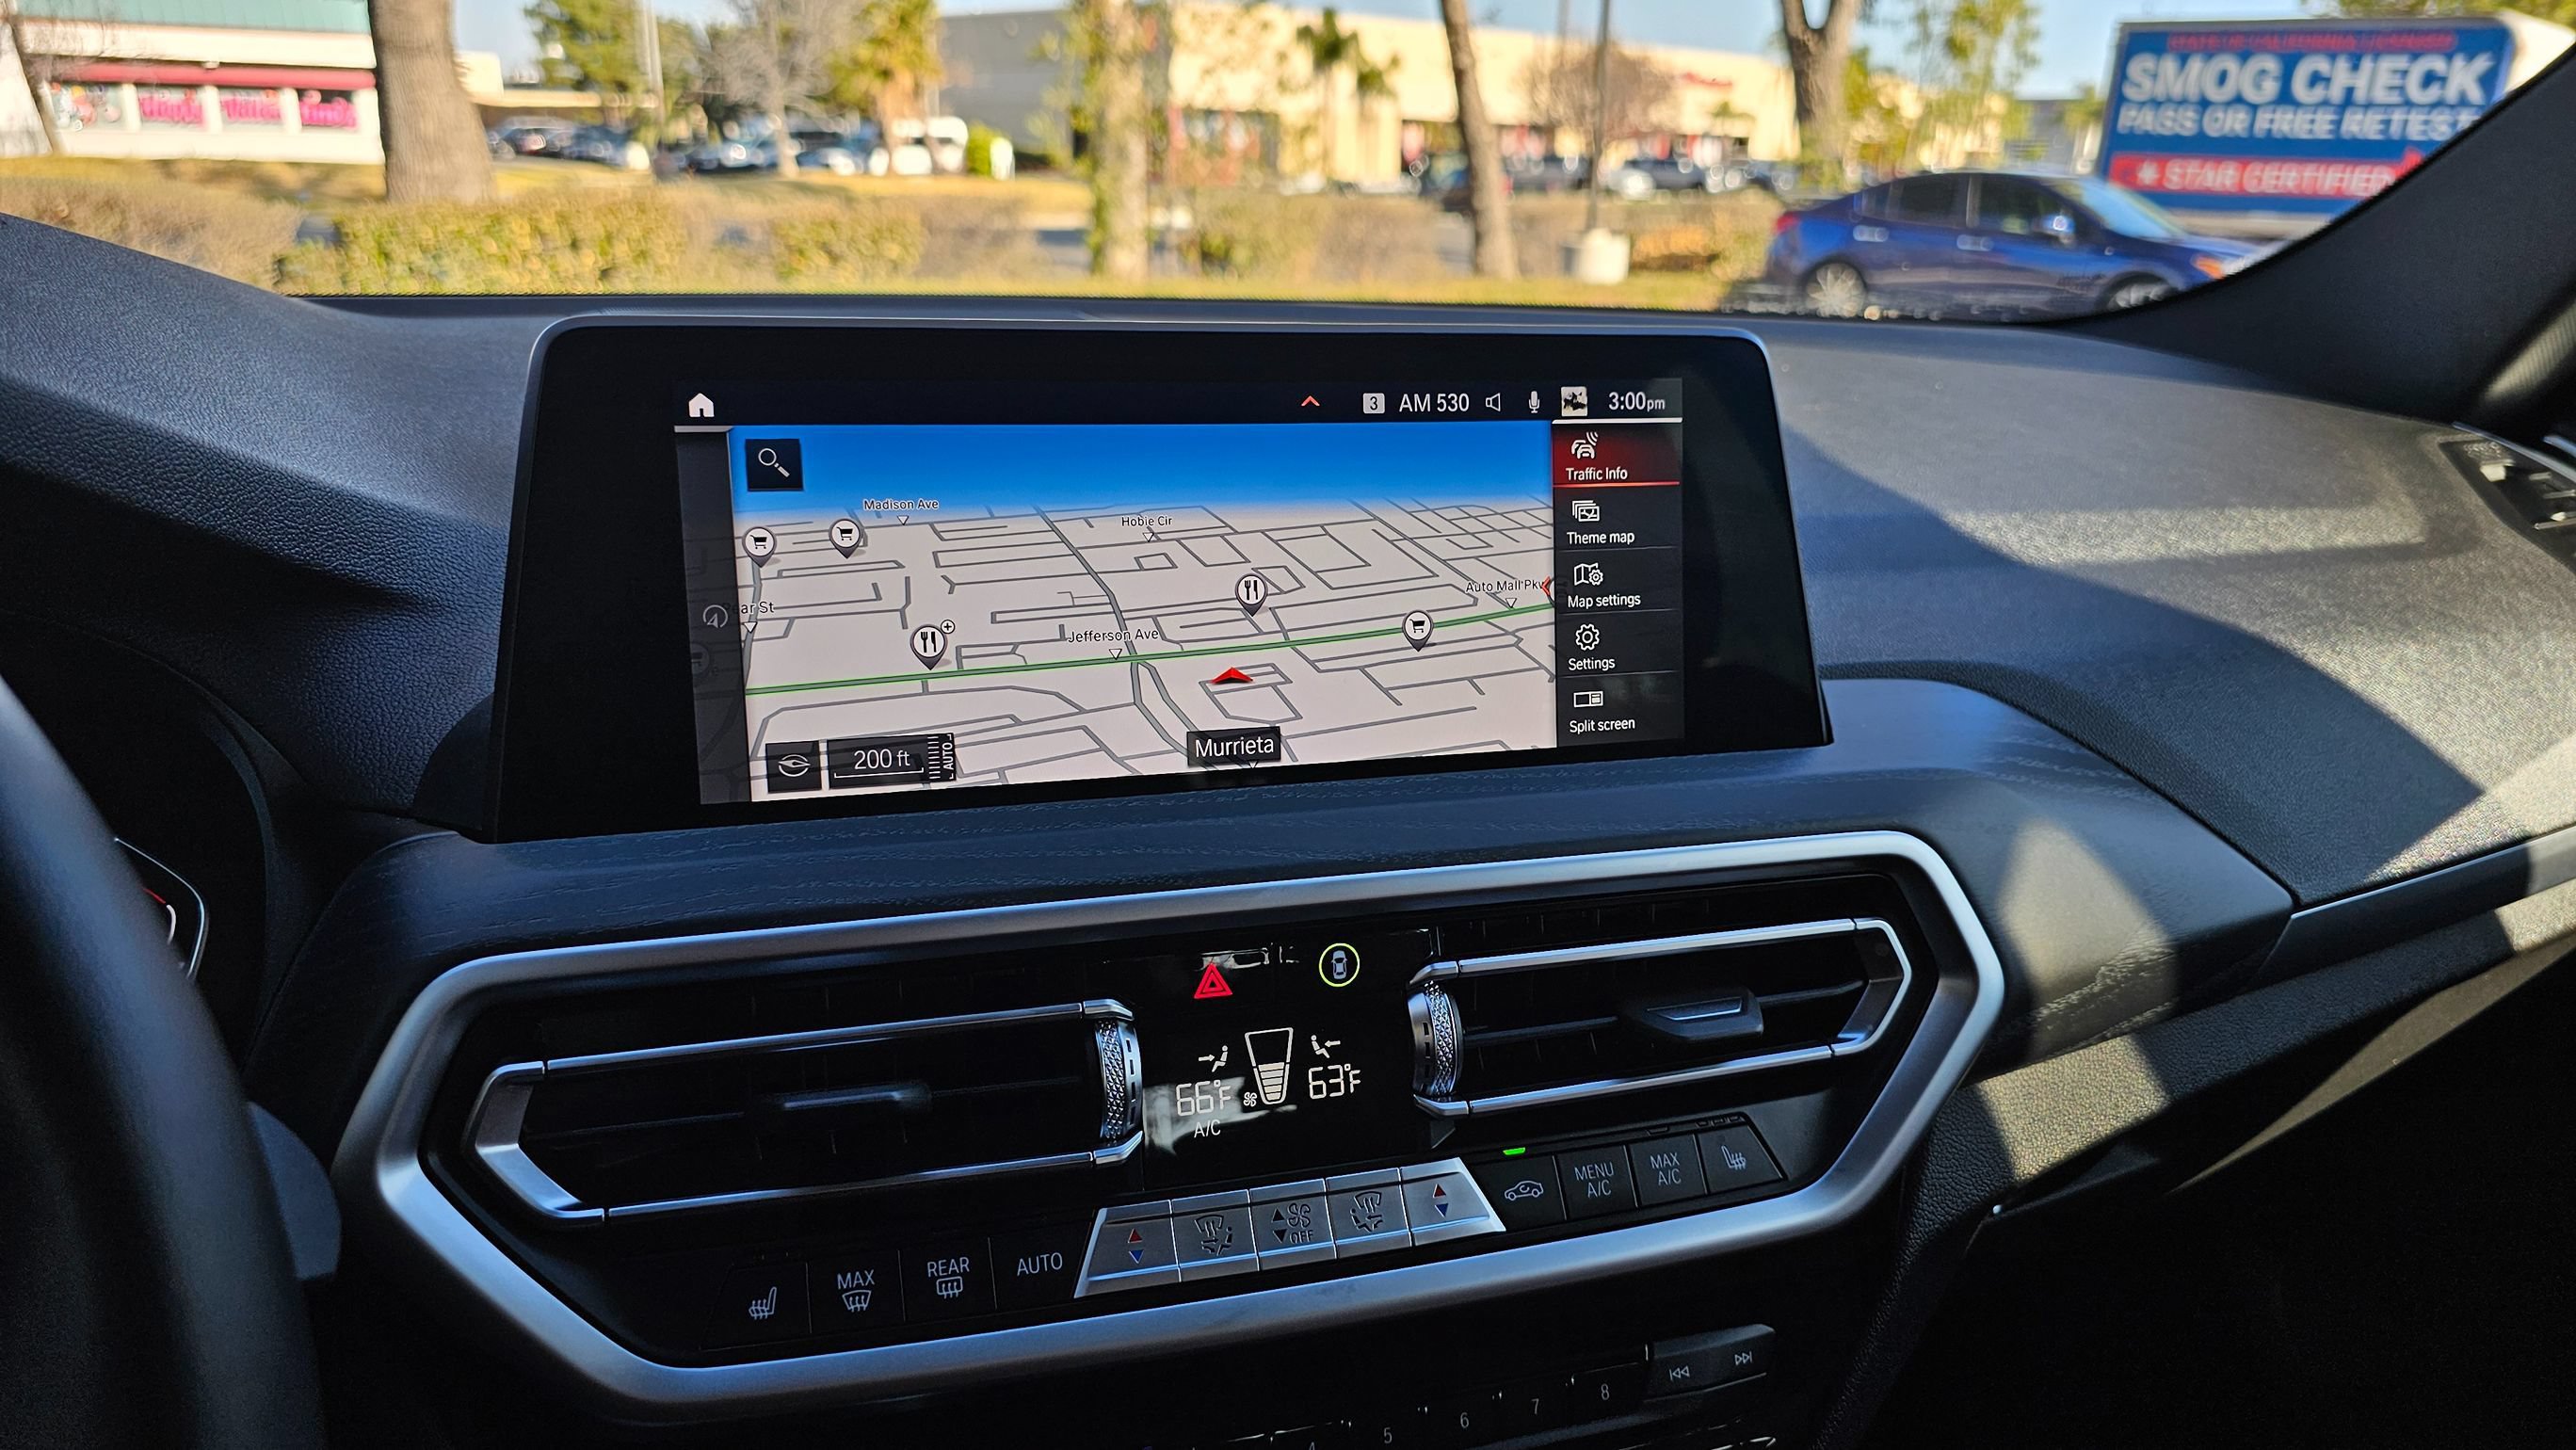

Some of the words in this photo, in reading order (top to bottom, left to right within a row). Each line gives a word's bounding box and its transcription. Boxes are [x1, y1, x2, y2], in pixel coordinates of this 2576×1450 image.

[2122, 53, 2282, 104] SMOG
[2291, 52, 2495, 105] CHECK
[2117, 104, 2199, 137] PASS
[2202, 105, 2250, 137] OR
[2254, 105, 2340, 140] FREE
[2163, 158, 2242, 191] STAR
[1399, 395, 1431, 412] AM
[1437, 394, 1470, 412] 530
[1608, 391, 1666, 411] 3:00pm
[1566, 467, 1602, 481] Traffic
[1605, 467, 1629, 480] Info
[863, 499, 914, 510] Madison
[917, 499, 940, 510] Ave
[1121, 516, 1154, 527] Hobie
[1157, 516, 1172, 525] Cir
[1567, 532, 1606, 545] Theme
[1608, 533, 1635, 546] map
[1466, 580, 1492, 592] Auto
[1496, 579, 1521, 590] Mall
[759, 601, 774, 613] St
[1568, 595, 1593, 610] Map
[1595, 593, 1641, 608] settings
[1068, 629, 1132, 643] Jefferson
[1134, 628, 1159, 640] Ave
[1568, 657, 1616, 671] Settings
[1570, 719, 1596, 734] Split
[1598, 718, 1635, 732] screen
[1195, 735, 1275, 758] Murrieta
[854, 749, 893, 769] 200
[896, 750, 910, 766] ft
[942, 742, 953, 770] AUTO
[1194, 1119, 1221, 1138] A/C
[1650, 1152, 1681, 1169] MAX
[1574, 1162, 1615, 1182] MENU
[1657, 1168, 1682, 1186] A/C
[1587, 1180, 1612, 1199] A/C
[1289, 1229, 1314, 1245] OFF
[926, 1256, 971, 1278] REAR
[1016, 1252, 1063, 1277] AUTO
[837, 1269, 876, 1290] MAX
[1601, 1383, 1610, 1401] 8
[1531, 1398, 1540, 1415] 7
[1460, 1412, 1470, 1428] 6
[1383, 1426, 1393, 1444] 5
